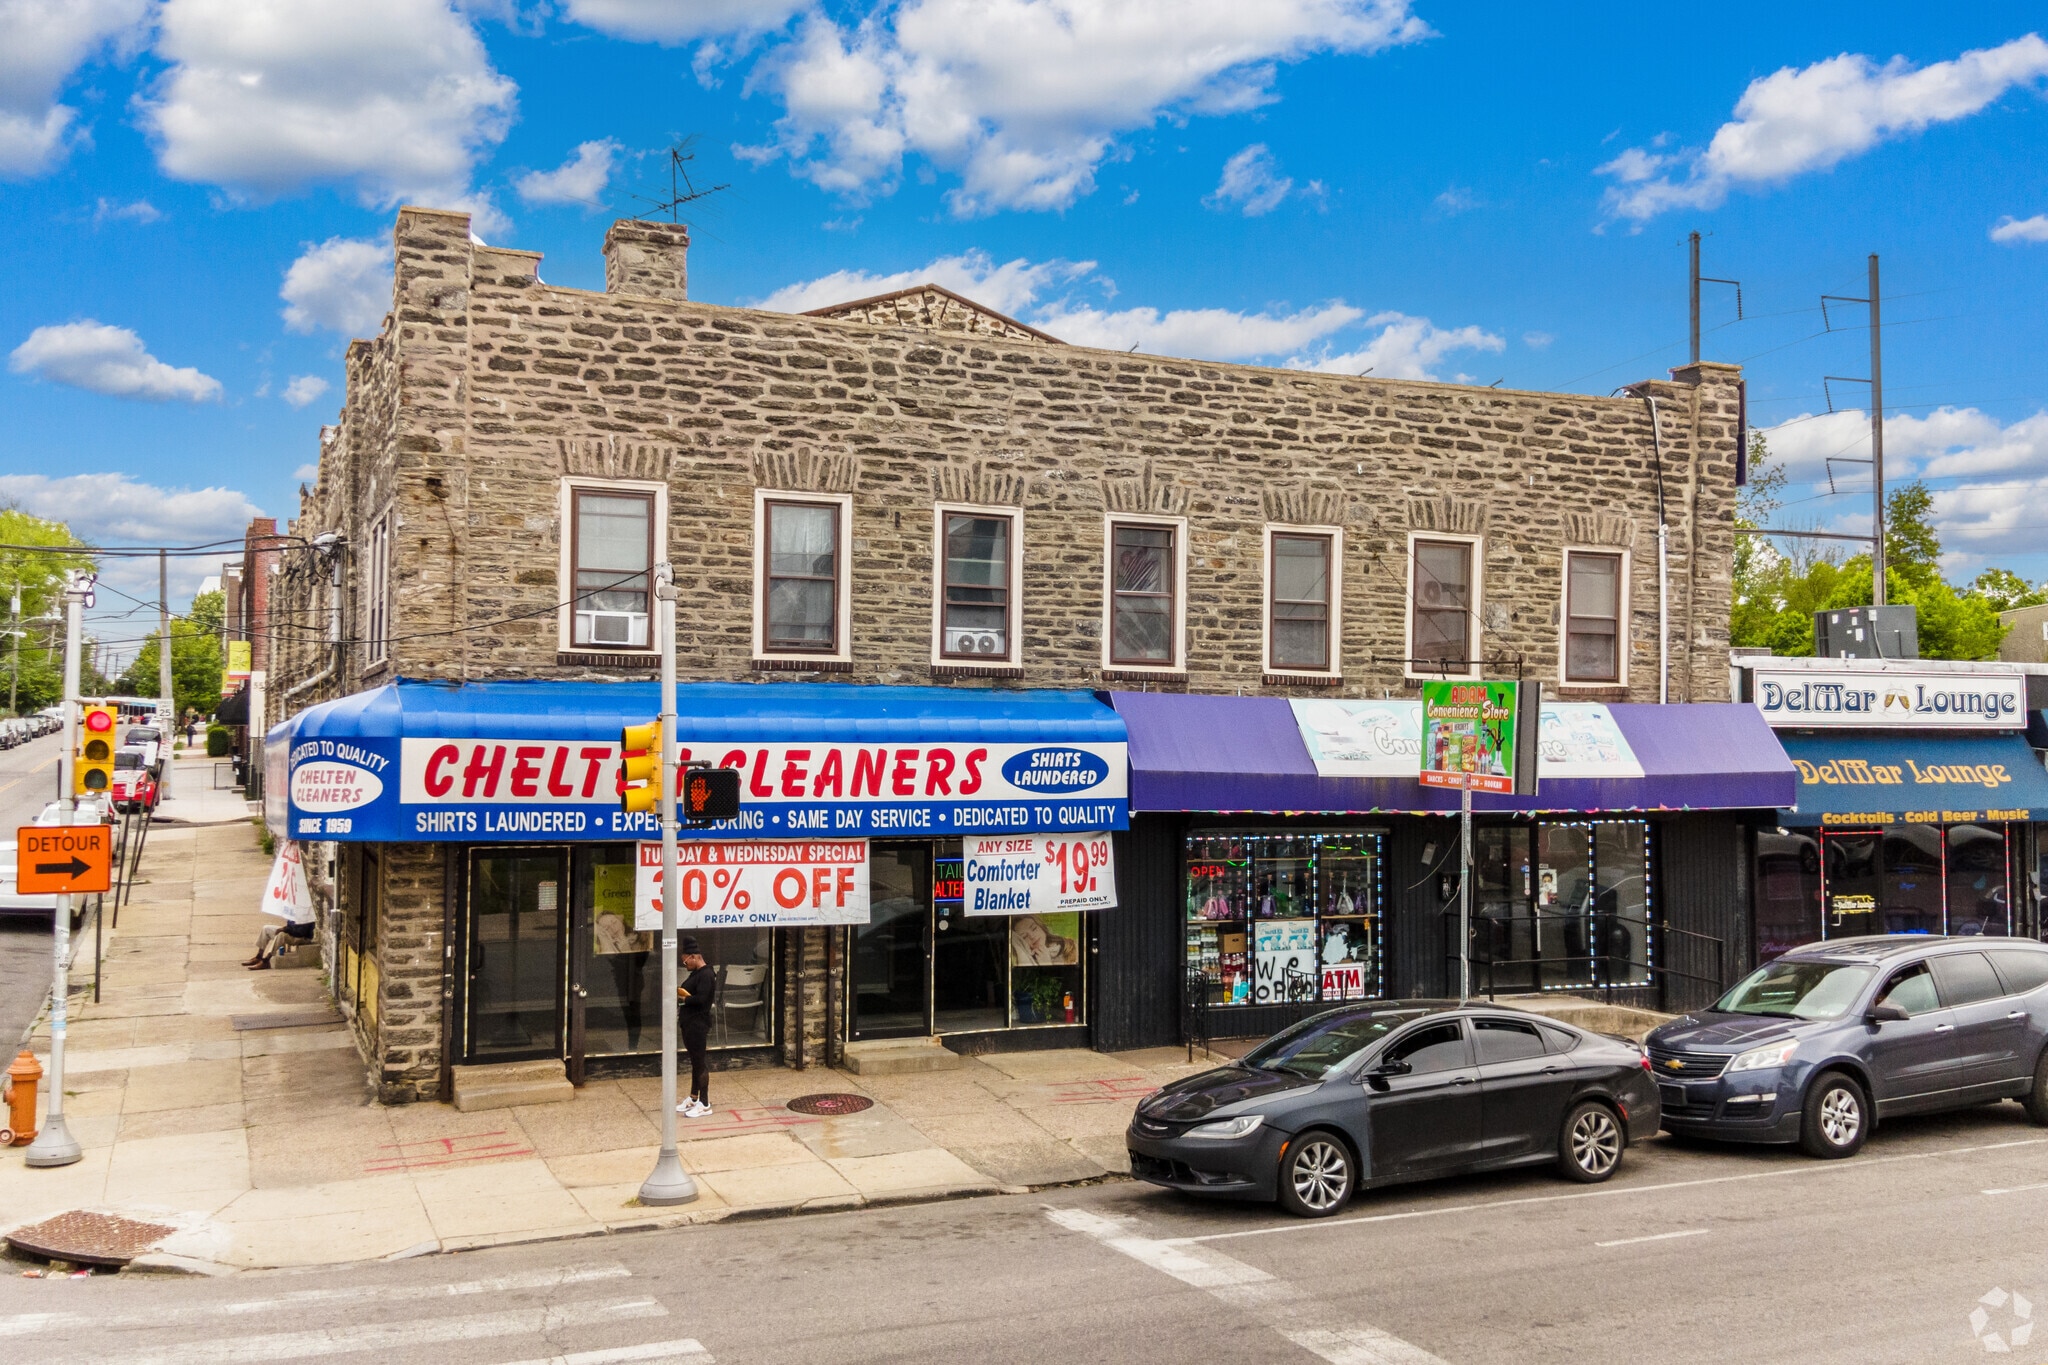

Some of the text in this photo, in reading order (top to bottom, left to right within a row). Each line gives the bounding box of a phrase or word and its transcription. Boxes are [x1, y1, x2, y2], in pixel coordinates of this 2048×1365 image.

[1451, 686, 1487, 704] ADAM
[1762, 681, 2017, 720] DelMar Lounge
[159, 709, 171, 717] 25
[1427, 697, 1509, 720] Convenience Store
[320, 741, 334, 756] TO
[337, 743, 389, 772] QUALITY
[1030, 751, 1082, 768] SHIRTS
[300, 770, 357, 785] CHELTEN
[1014, 769, 1098, 786] LAUNDERED
[1793, 759, 2012, 788] DelMar Lounge
[296, 788, 363, 803] CLEANERS
[298, 818, 352, 833] SINCE 1959
[416, 812, 477, 832] SHIRTS
[485, 812, 586, 832] LAUNDERED
[788, 809, 828, 829] SAME
[836, 809, 863, 828] DAY
[871, 808, 931, 828] SERVICE
[954, 807, 1028, 827] DEDICATED
[1034, 807, 1052, 825] TO
[1058, 805, 1116, 825] QUALITY
[1822, 809, 2029, 825] Cocktails Cold Beer Music
[27, 835, 100, 852] DETOUR
[977, 839, 1033, 853] ANY SIZE
[708, 846, 718, 862] &
[723, 846, 802, 862] WEDNESDAY
[809, 845, 862, 861] SPECIAL
[967, 858, 1041, 882] Comforter
[1191, 866, 1225, 877] OPEN
[602, 888, 631, 899] Green
[772, 868, 855, 909] OFF
[974, 887, 1031, 910] Blanket
[1060, 897, 1088, 905] PREPAID
[704, 914, 744, 924] PREPAY
[749, 913, 777, 923] ONLY
[1322, 969, 1361, 989] ATM
